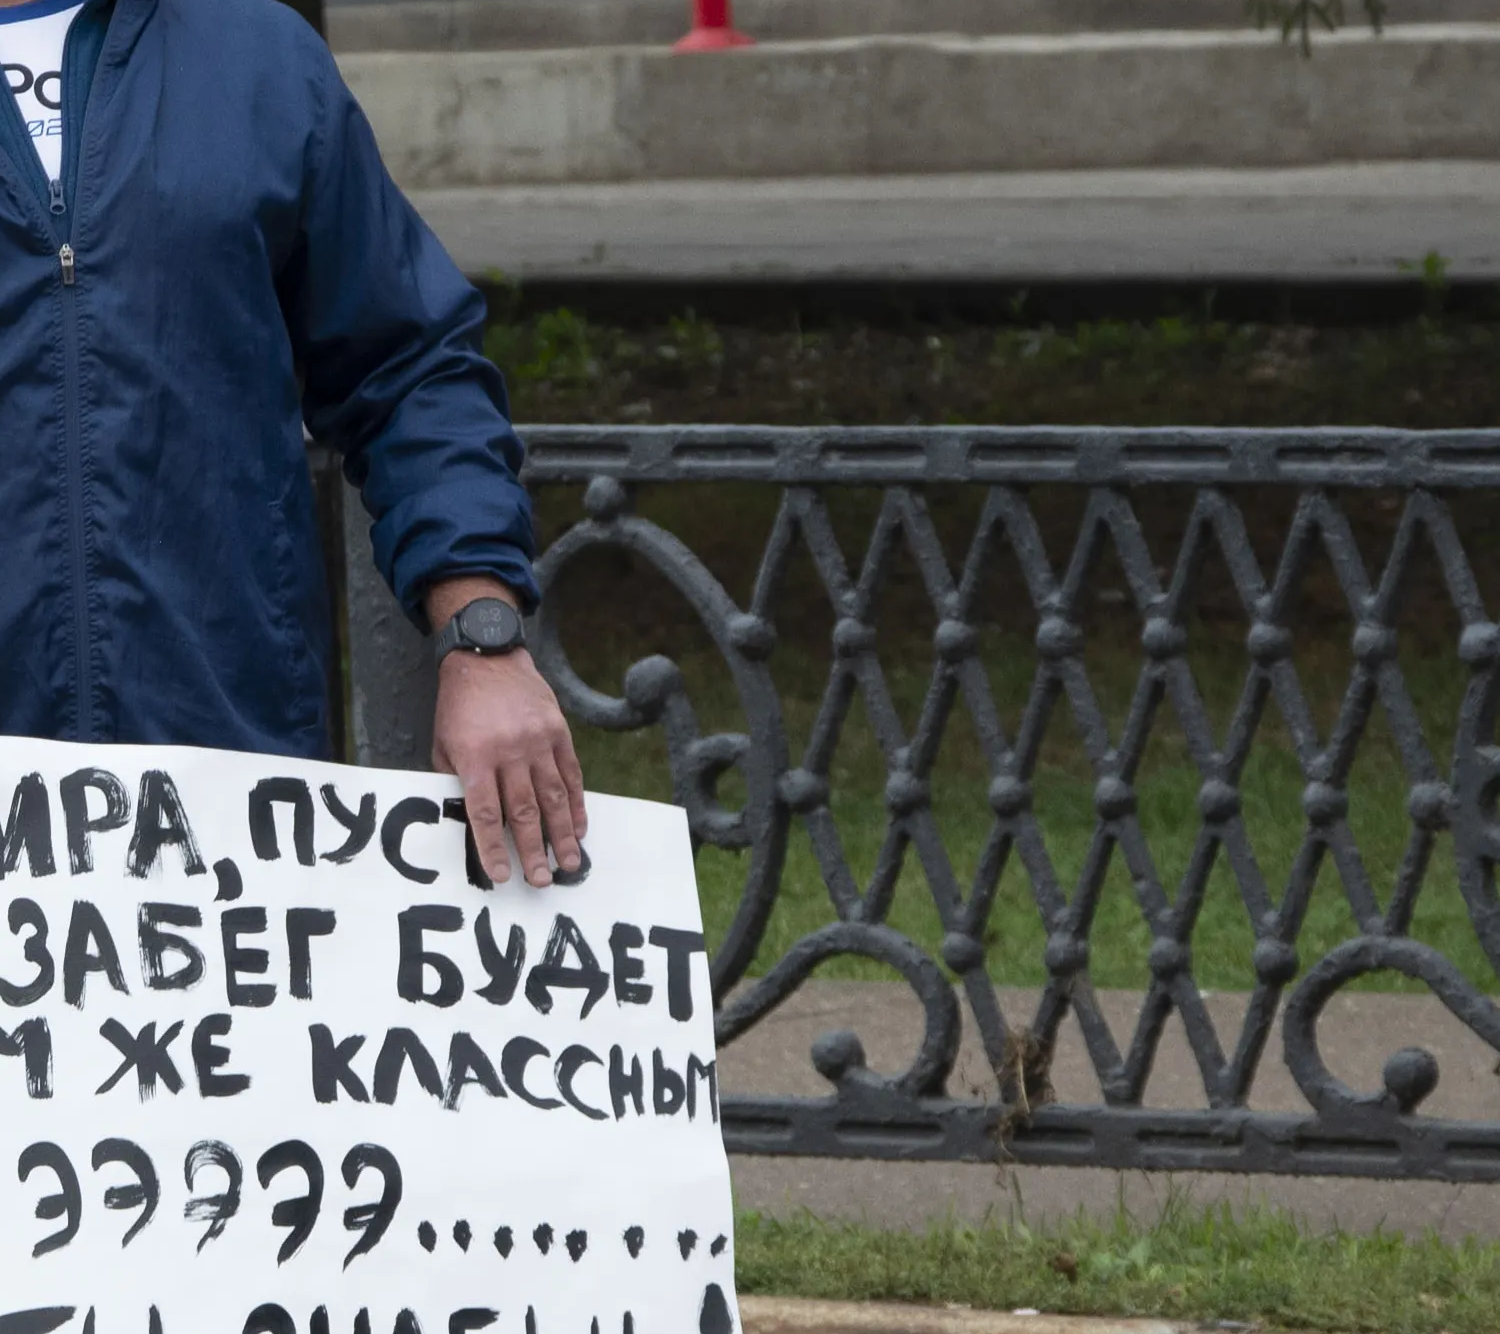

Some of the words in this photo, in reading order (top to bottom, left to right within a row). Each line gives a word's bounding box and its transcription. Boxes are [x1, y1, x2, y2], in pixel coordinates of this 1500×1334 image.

[397, 903, 705, 1022] БУДЕТ
[94, 1013, 252, 1104] ЖЕ
[308, 1024, 719, 1123] КЛАССНЫМ
